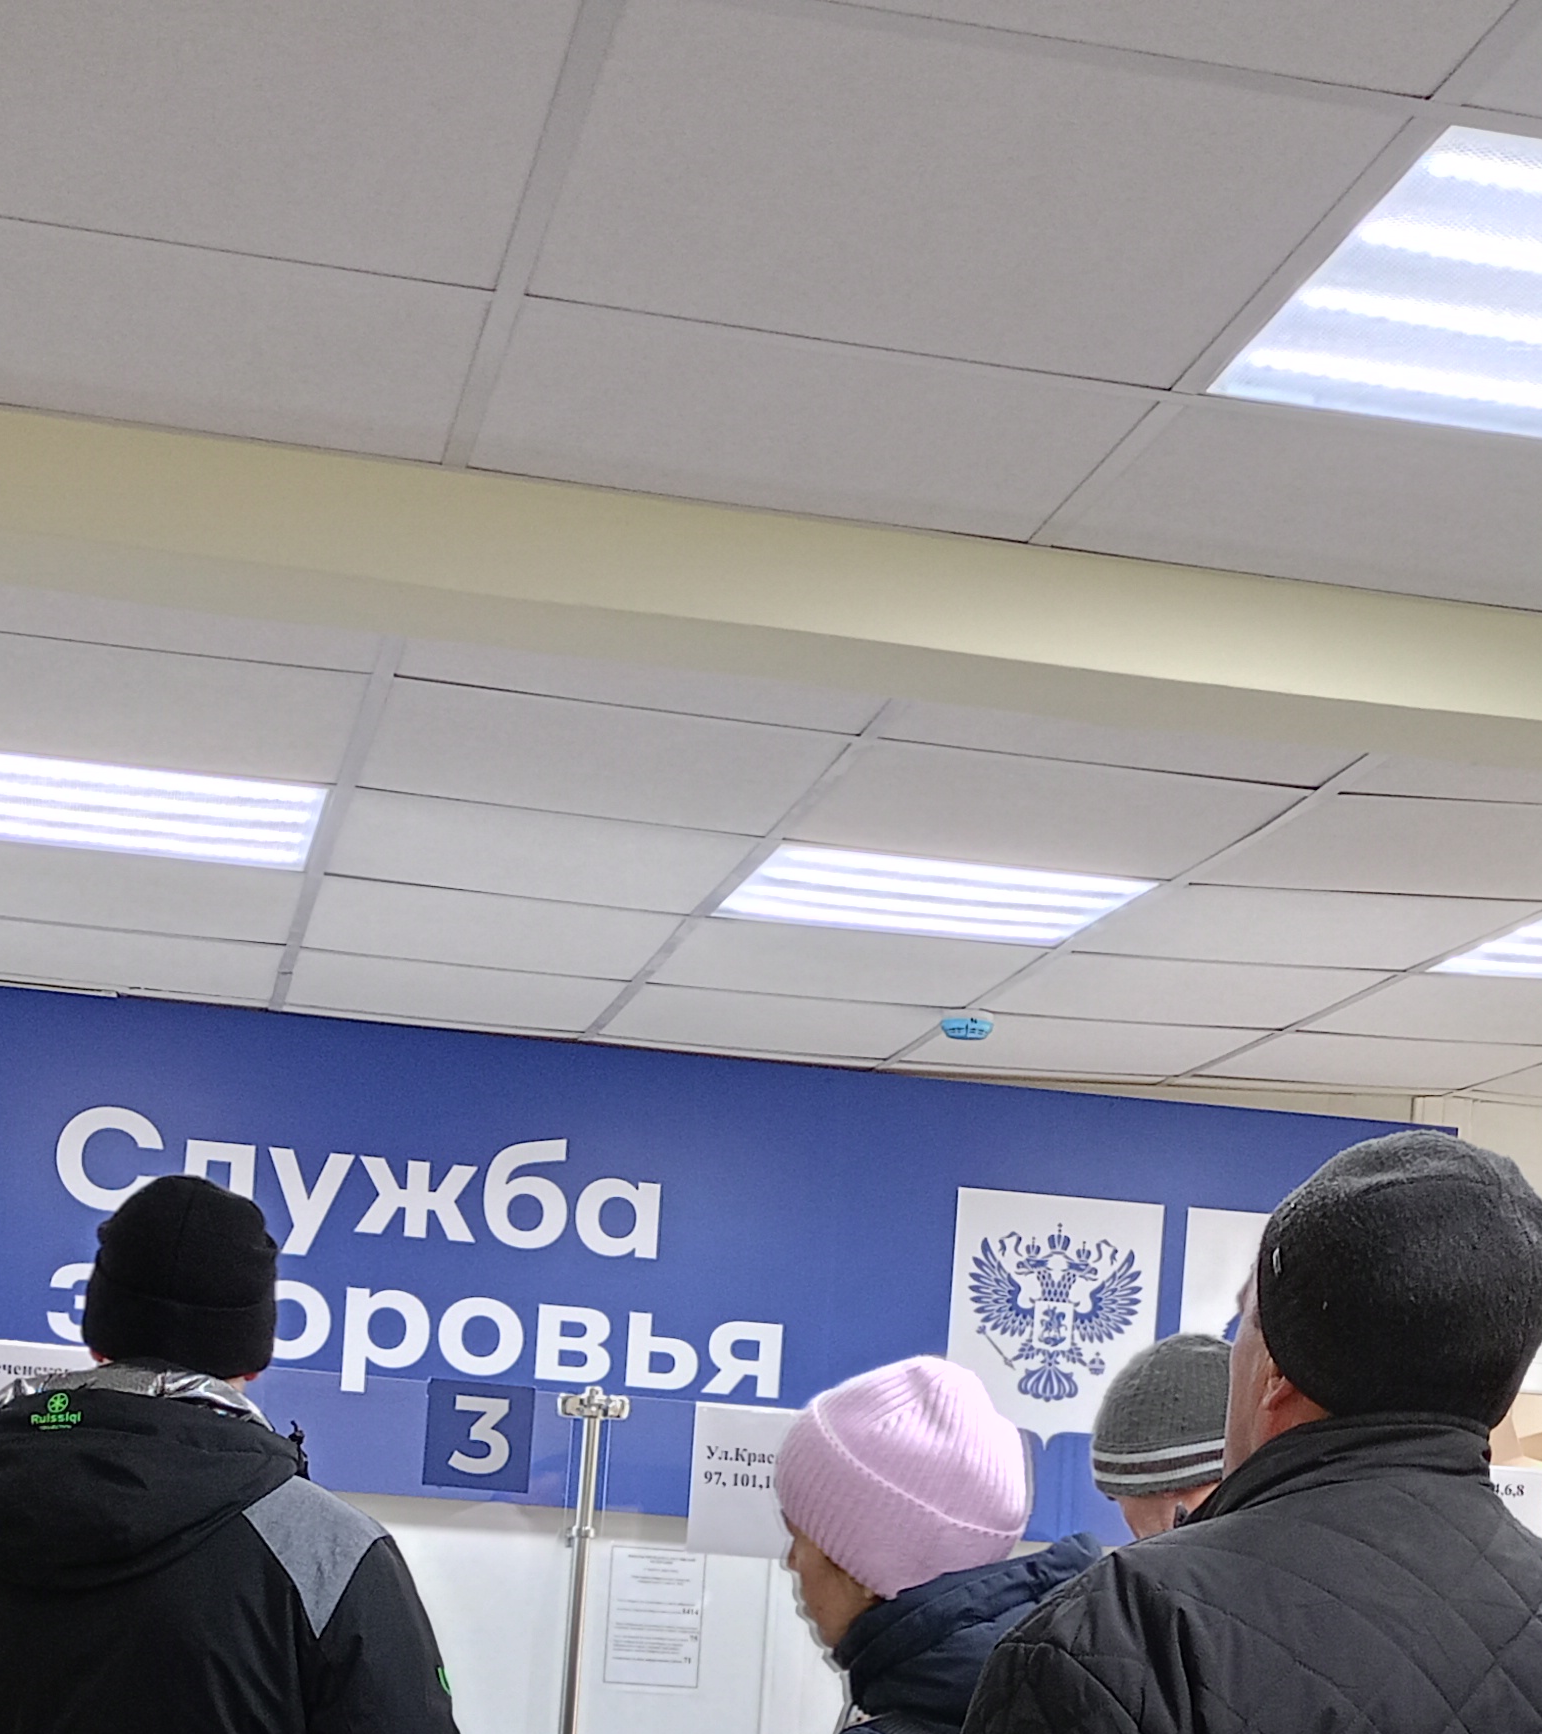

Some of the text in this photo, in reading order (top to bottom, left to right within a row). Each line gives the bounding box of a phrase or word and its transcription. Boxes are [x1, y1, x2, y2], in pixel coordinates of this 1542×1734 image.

[55, 1105, 662, 1259] Служба
[47, 1262, 784, 1398] зоровья
[447, 1395, 512, 1475] 3
[706, 1445, 776, 1467] Ул.Крас
[703, 1470, 772, 1491] 97, 101,1
